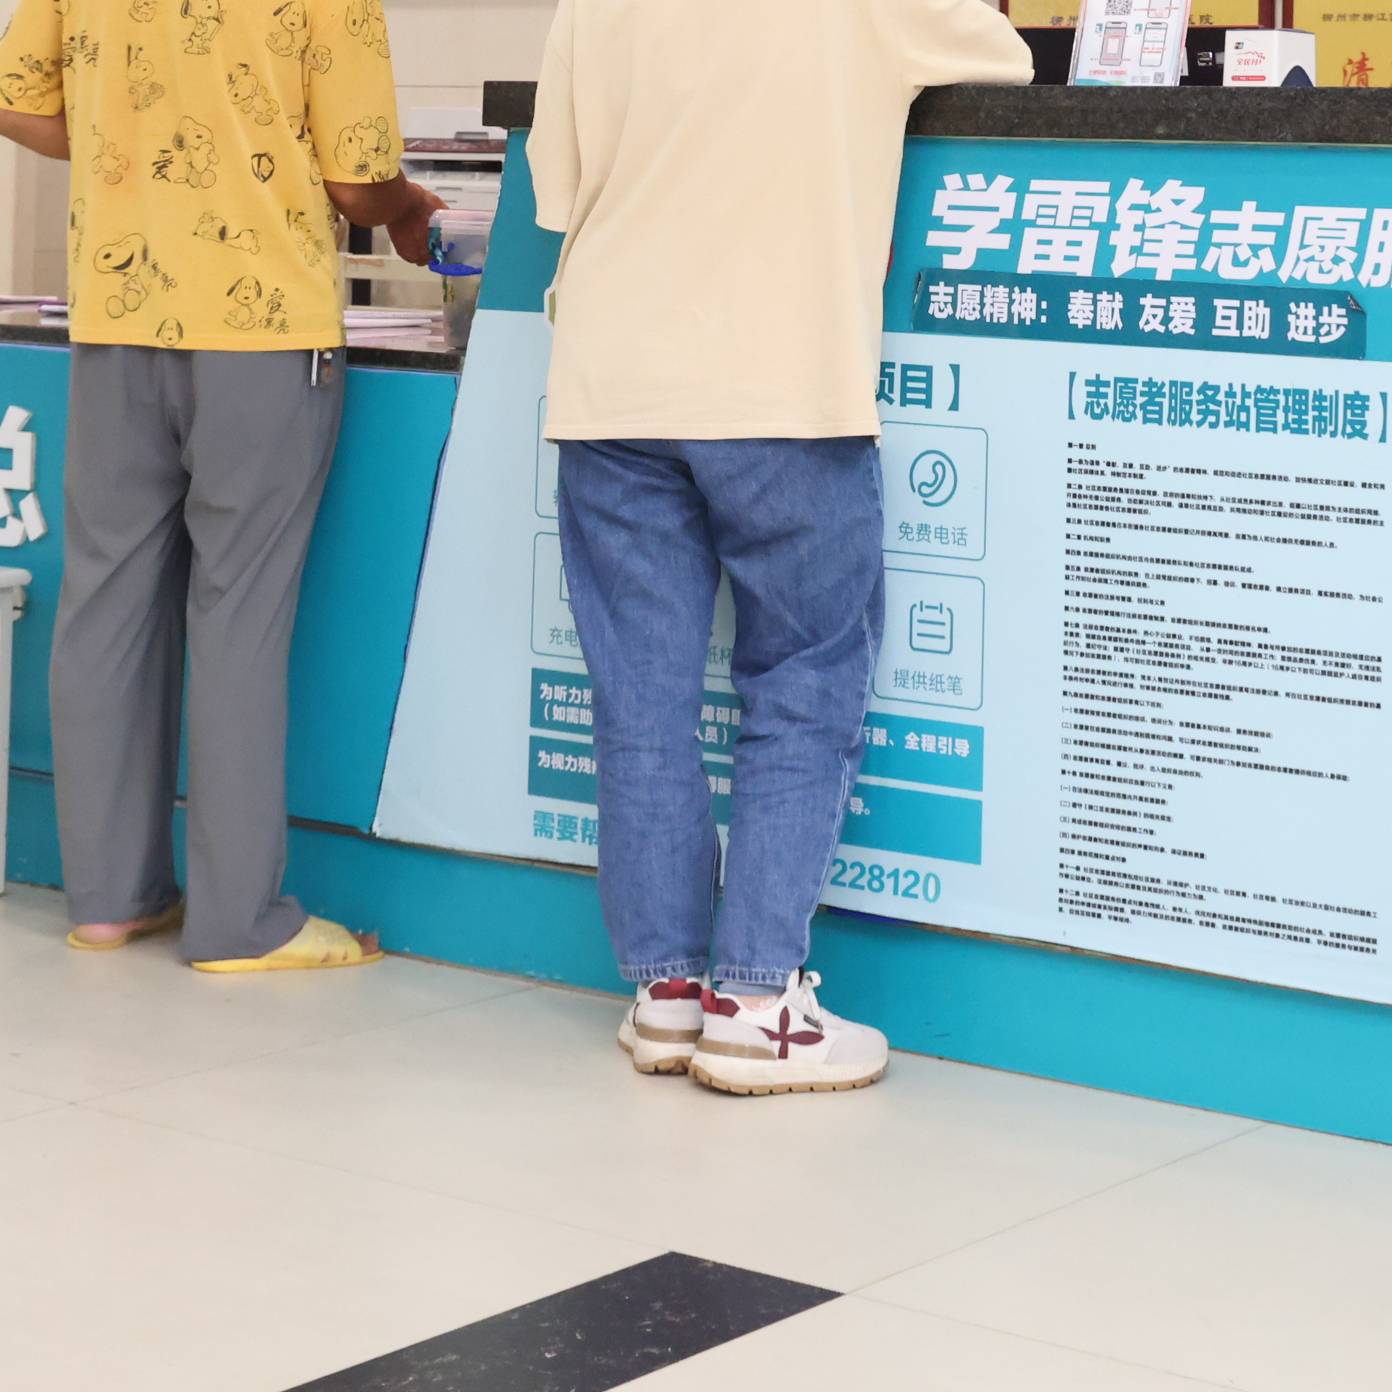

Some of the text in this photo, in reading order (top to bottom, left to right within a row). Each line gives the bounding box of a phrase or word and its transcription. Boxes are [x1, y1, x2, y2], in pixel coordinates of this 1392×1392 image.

[1066, 286, 1125, 333] 奉献
[1138, 291, 1197, 338] 友爱
[1211, 296, 1270, 343] 互助
[1286, 300, 1350, 346] 进步
[1067, 371, 1389, 444] 【志愿者服务站管理制度】
[897, 519, 970, 549] 免费电话
[892, 668, 964, 698] 提供纸笔
[537, 750, 598, 776] 为视力残
[829, 858, 942, 904] 228120
